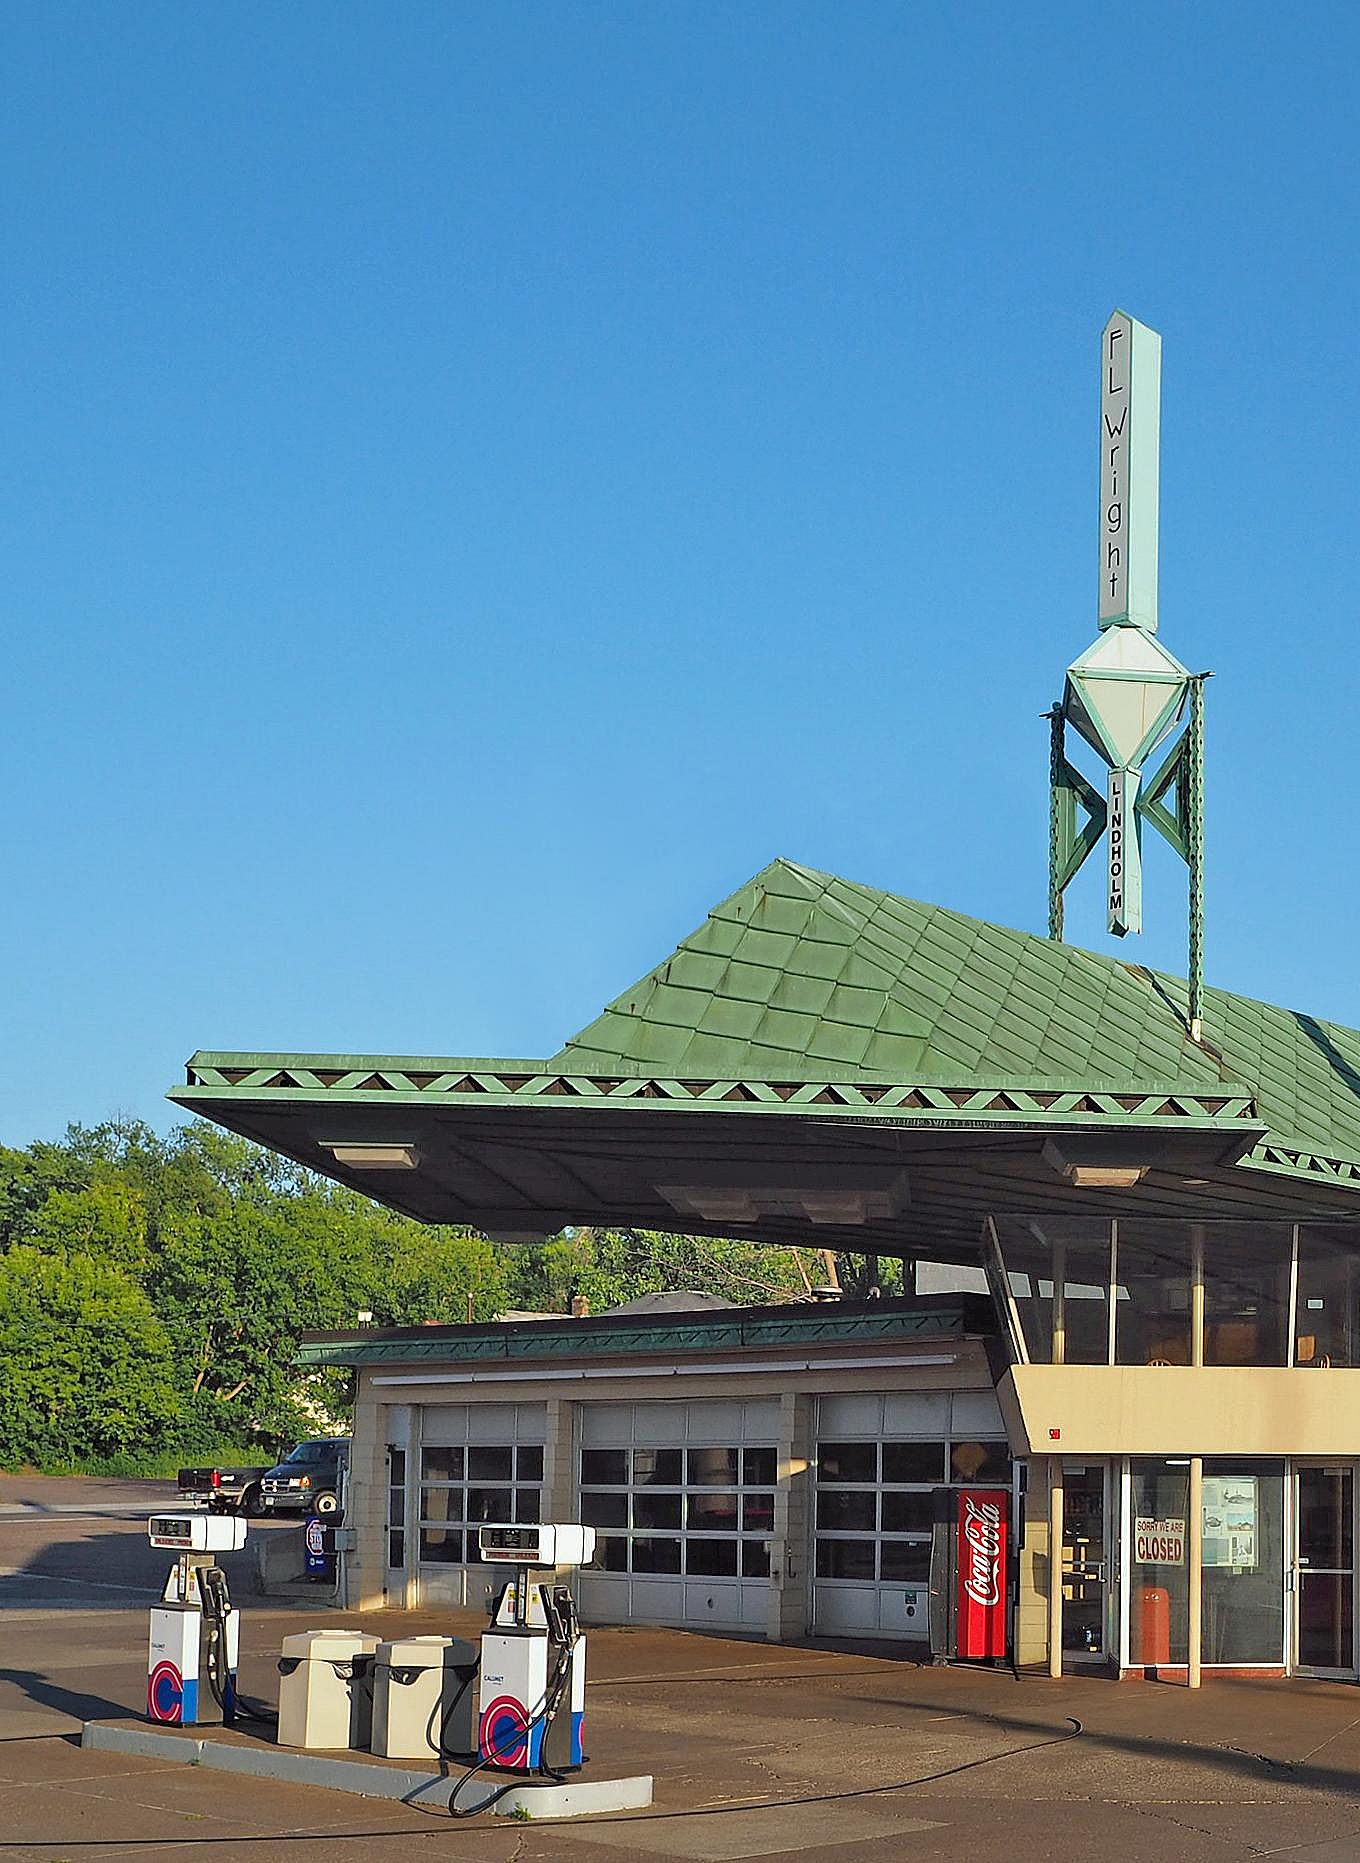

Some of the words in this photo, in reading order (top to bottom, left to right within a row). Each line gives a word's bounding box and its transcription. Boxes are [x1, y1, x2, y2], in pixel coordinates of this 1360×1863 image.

[1110, 782, 1122, 909] LINDHOLM
[1138, 1521, 1158, 1531] SORRY
[1159, 1521, 1169, 1532] WE
[1171, 1522, 1183, 1533] ARE
[1138, 1536, 1181, 1561] CLOSED
